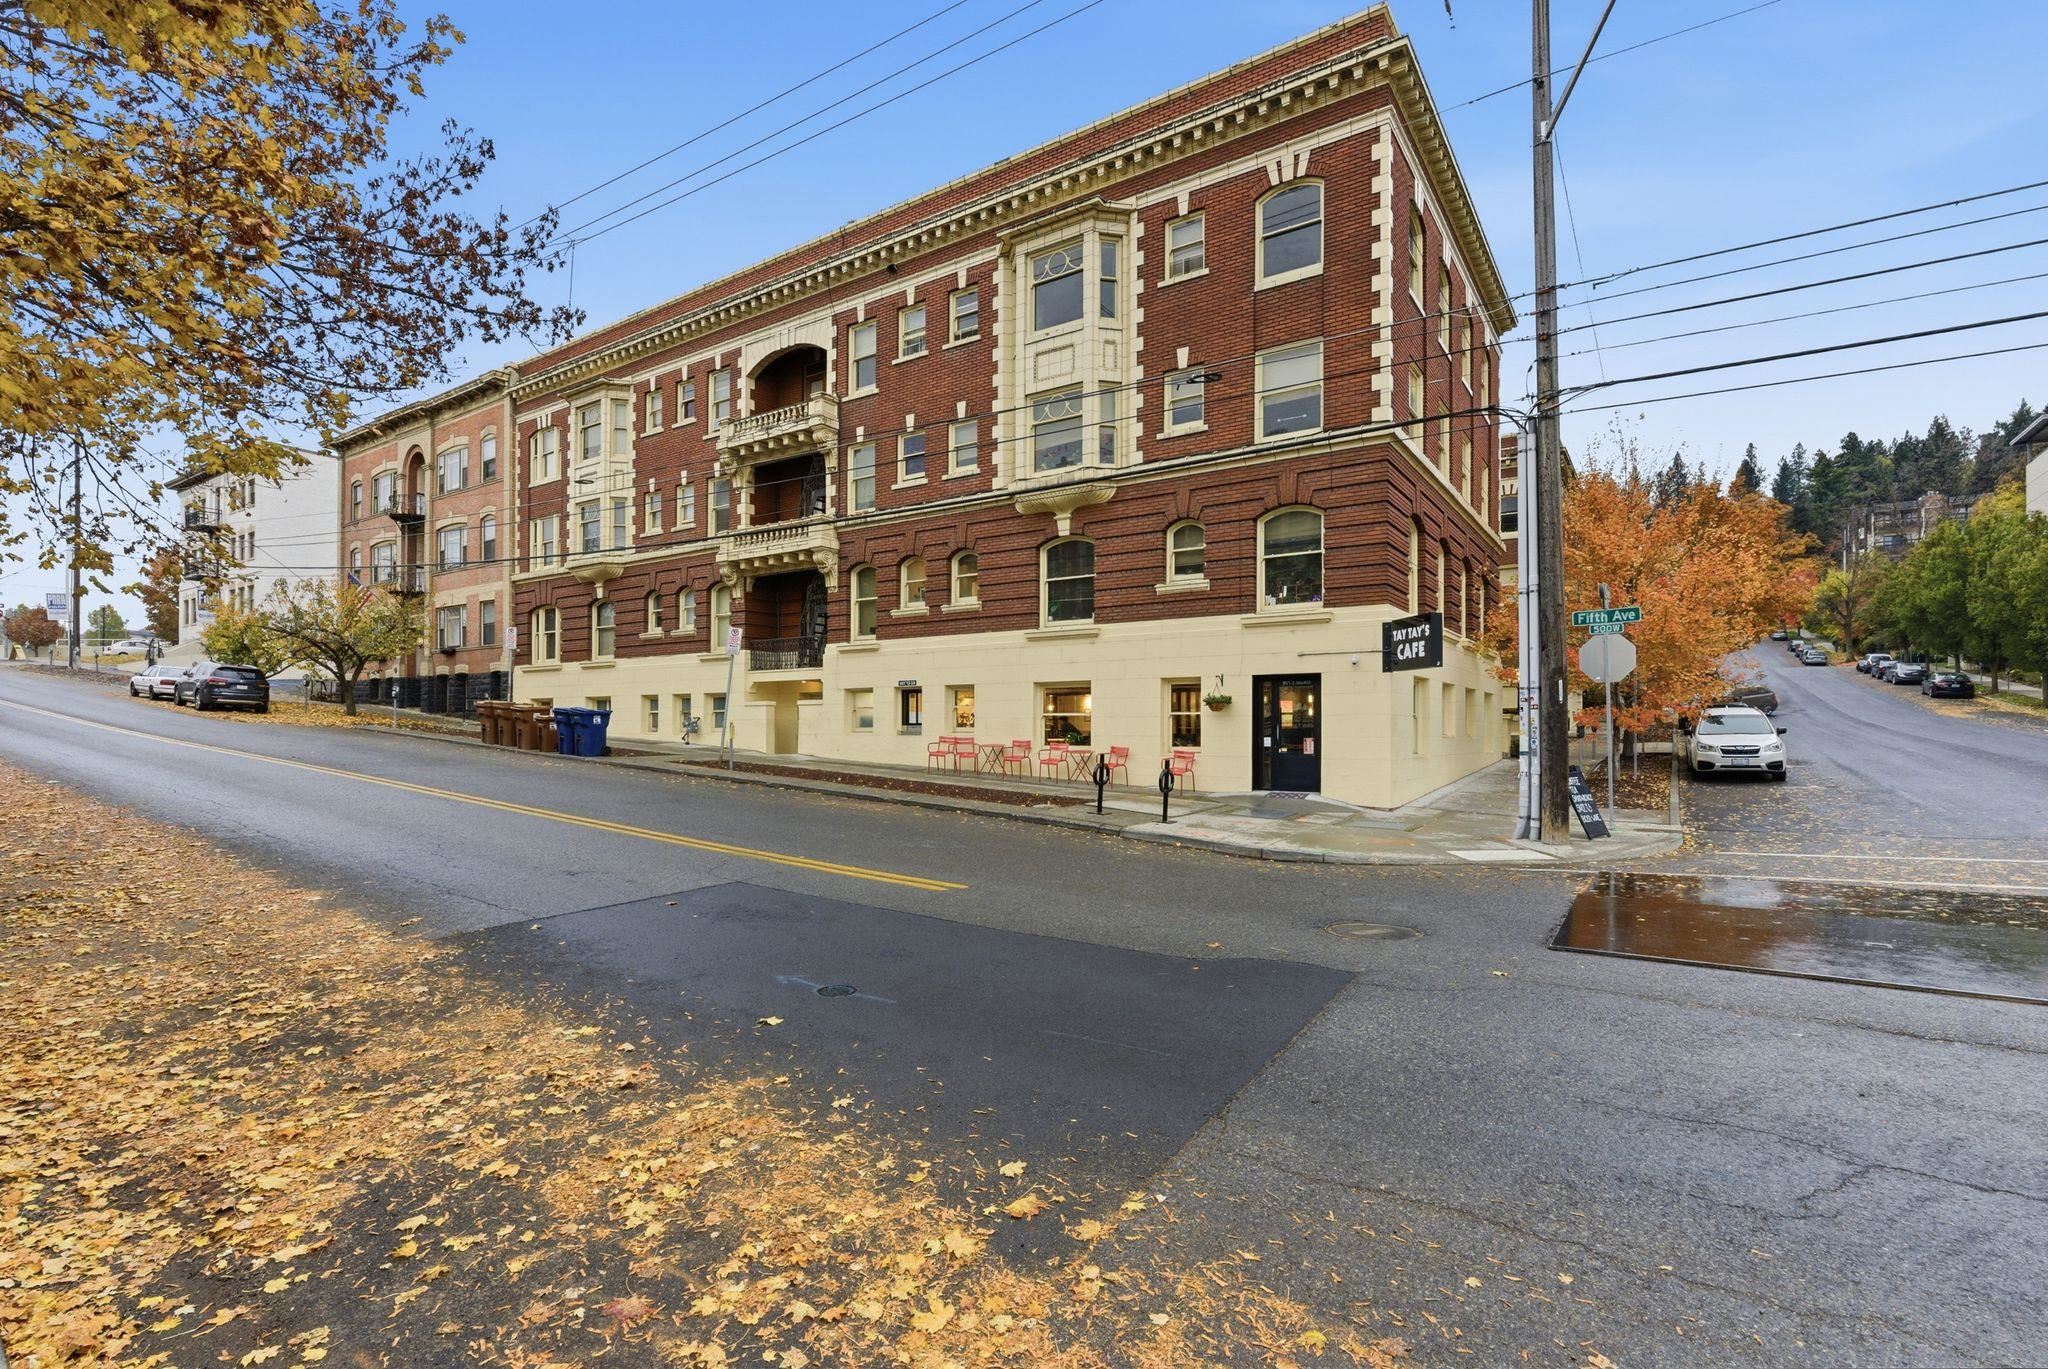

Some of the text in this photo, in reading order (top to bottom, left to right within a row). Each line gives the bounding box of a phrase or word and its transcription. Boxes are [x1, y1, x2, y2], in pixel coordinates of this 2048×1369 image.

[1577, 610, 1636, 624] Fifth Ave
[1392, 623, 1430, 642] TAY TAY'S
[1593, 624, 1620, 633] 500W
[1397, 640, 1426, 660] CAFE
